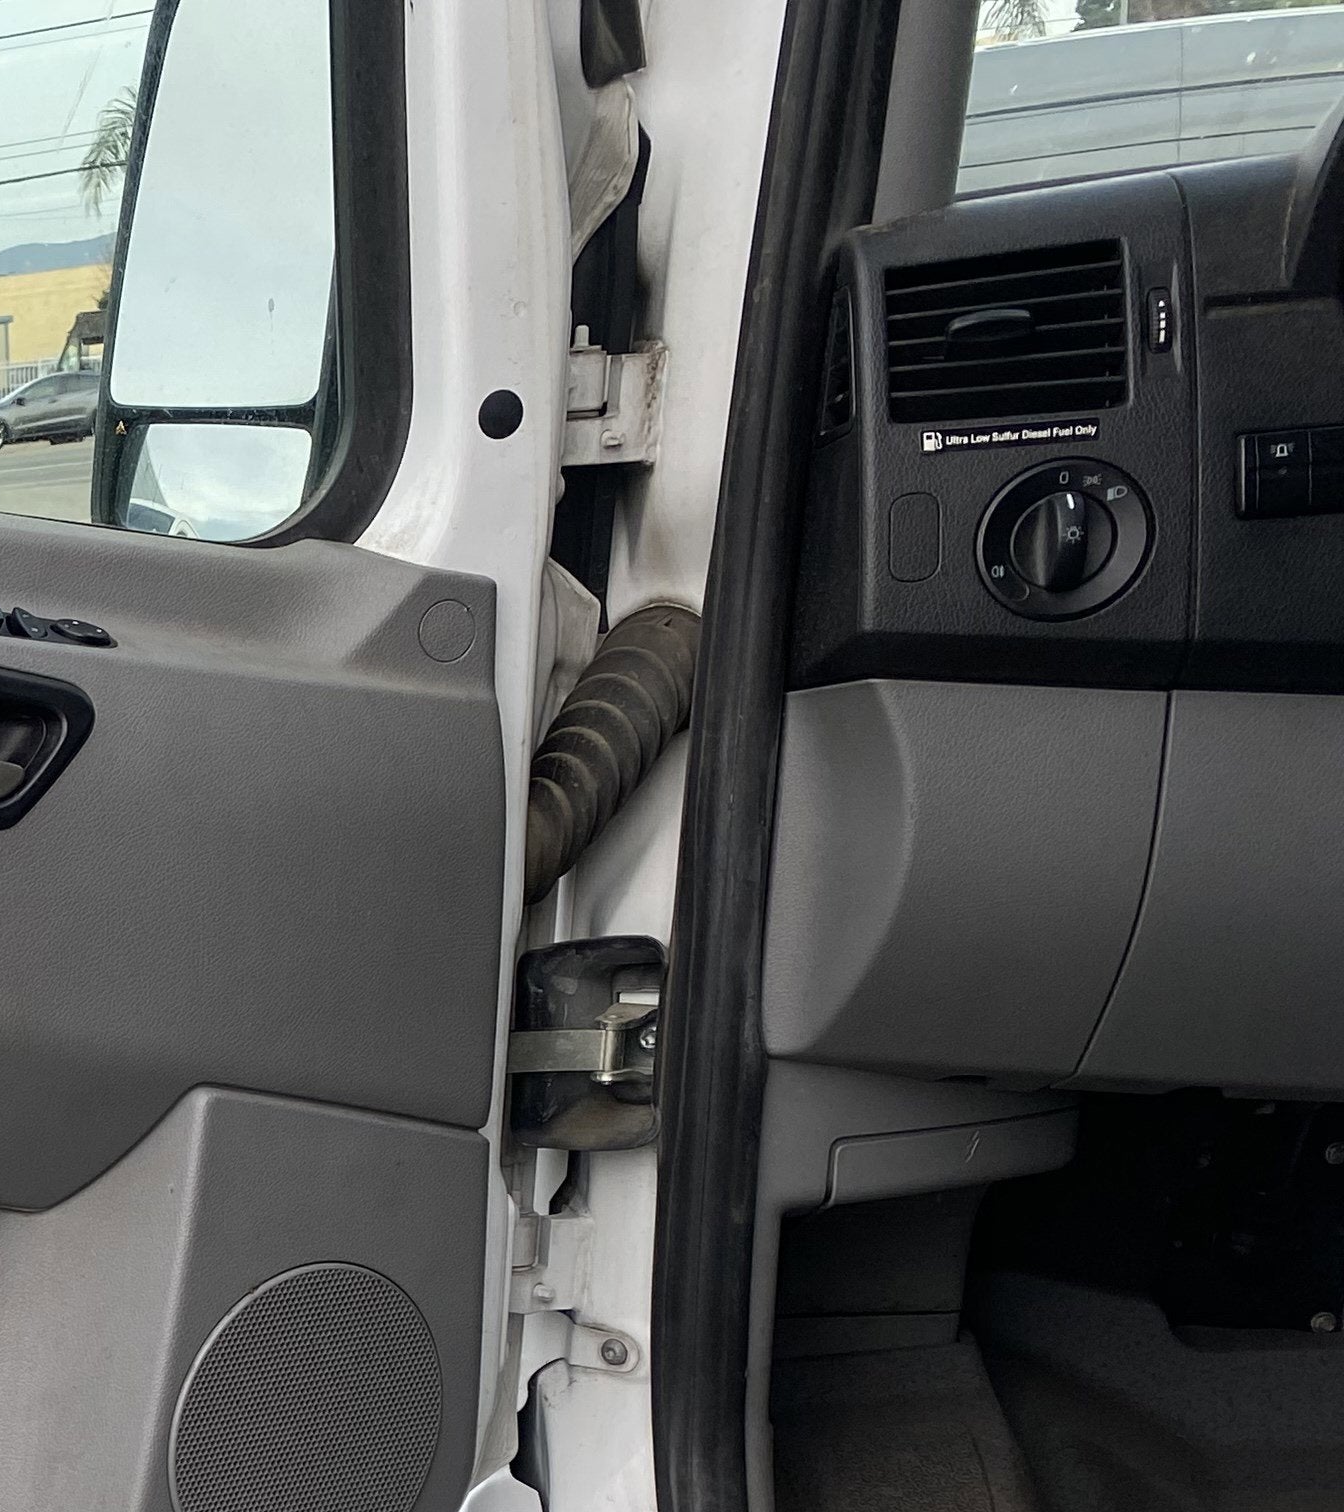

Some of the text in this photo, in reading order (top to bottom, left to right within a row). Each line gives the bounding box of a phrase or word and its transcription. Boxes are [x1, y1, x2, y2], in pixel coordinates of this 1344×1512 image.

[945, 424, 1098, 446] Ultra Low Sulfur Diesel Fuel Only
